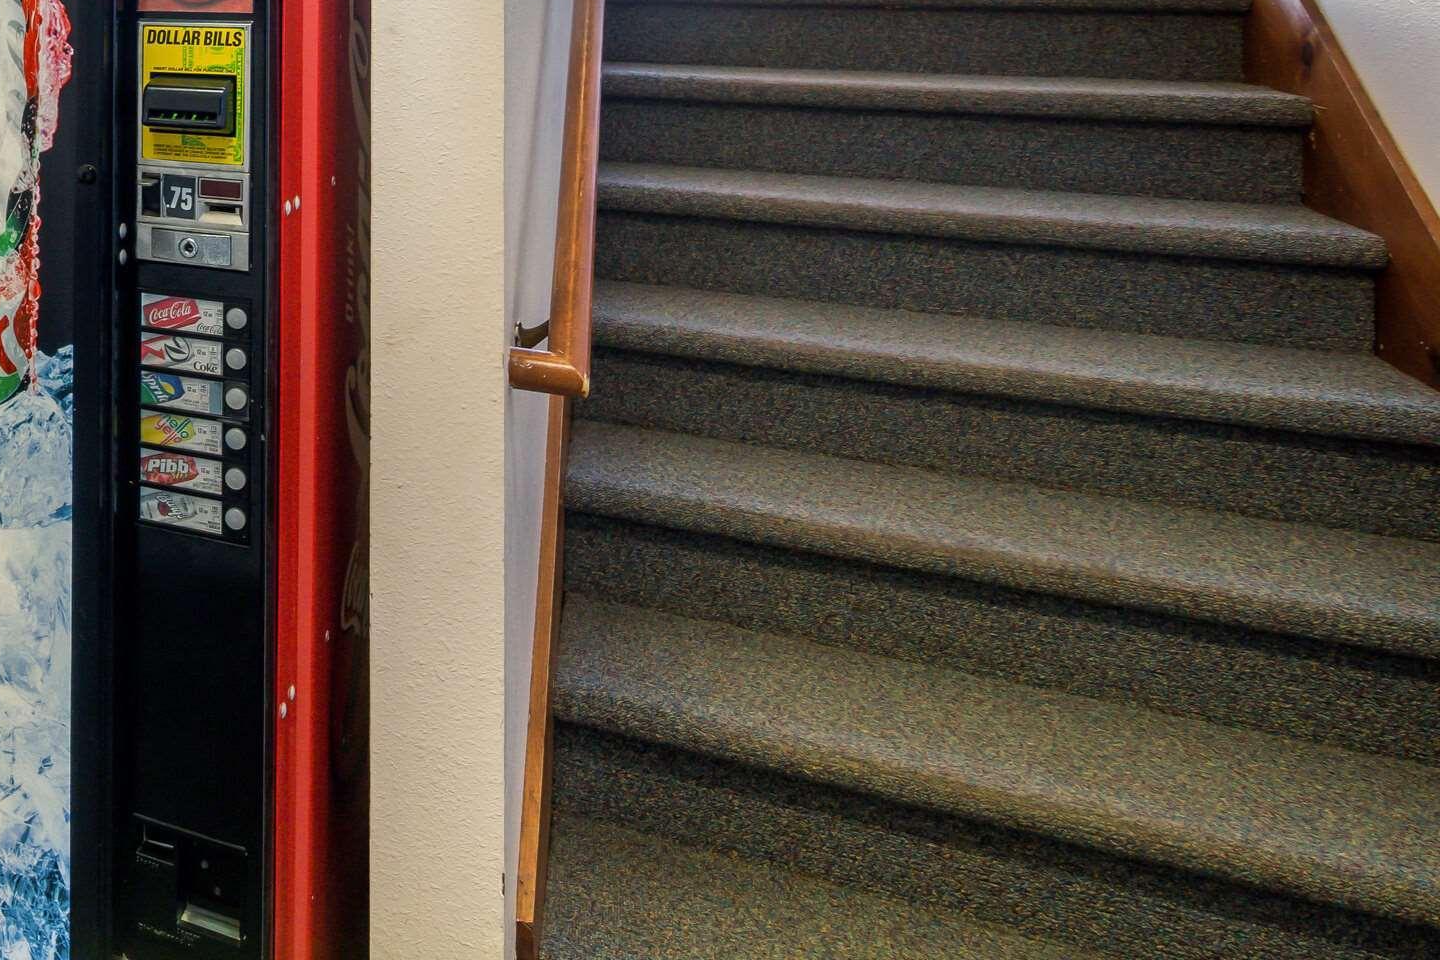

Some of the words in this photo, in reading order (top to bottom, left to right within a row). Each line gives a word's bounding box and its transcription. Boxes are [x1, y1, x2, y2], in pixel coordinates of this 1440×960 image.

[146, 29, 202, 46] DOLLAR
[203, 31, 243, 47] BILLS
[166, 185, 193, 211] .75
[149, 301, 192, 325] Coca-Cola
[193, 361, 218, 373] Coke
[147, 458, 190, 474] Pibb
